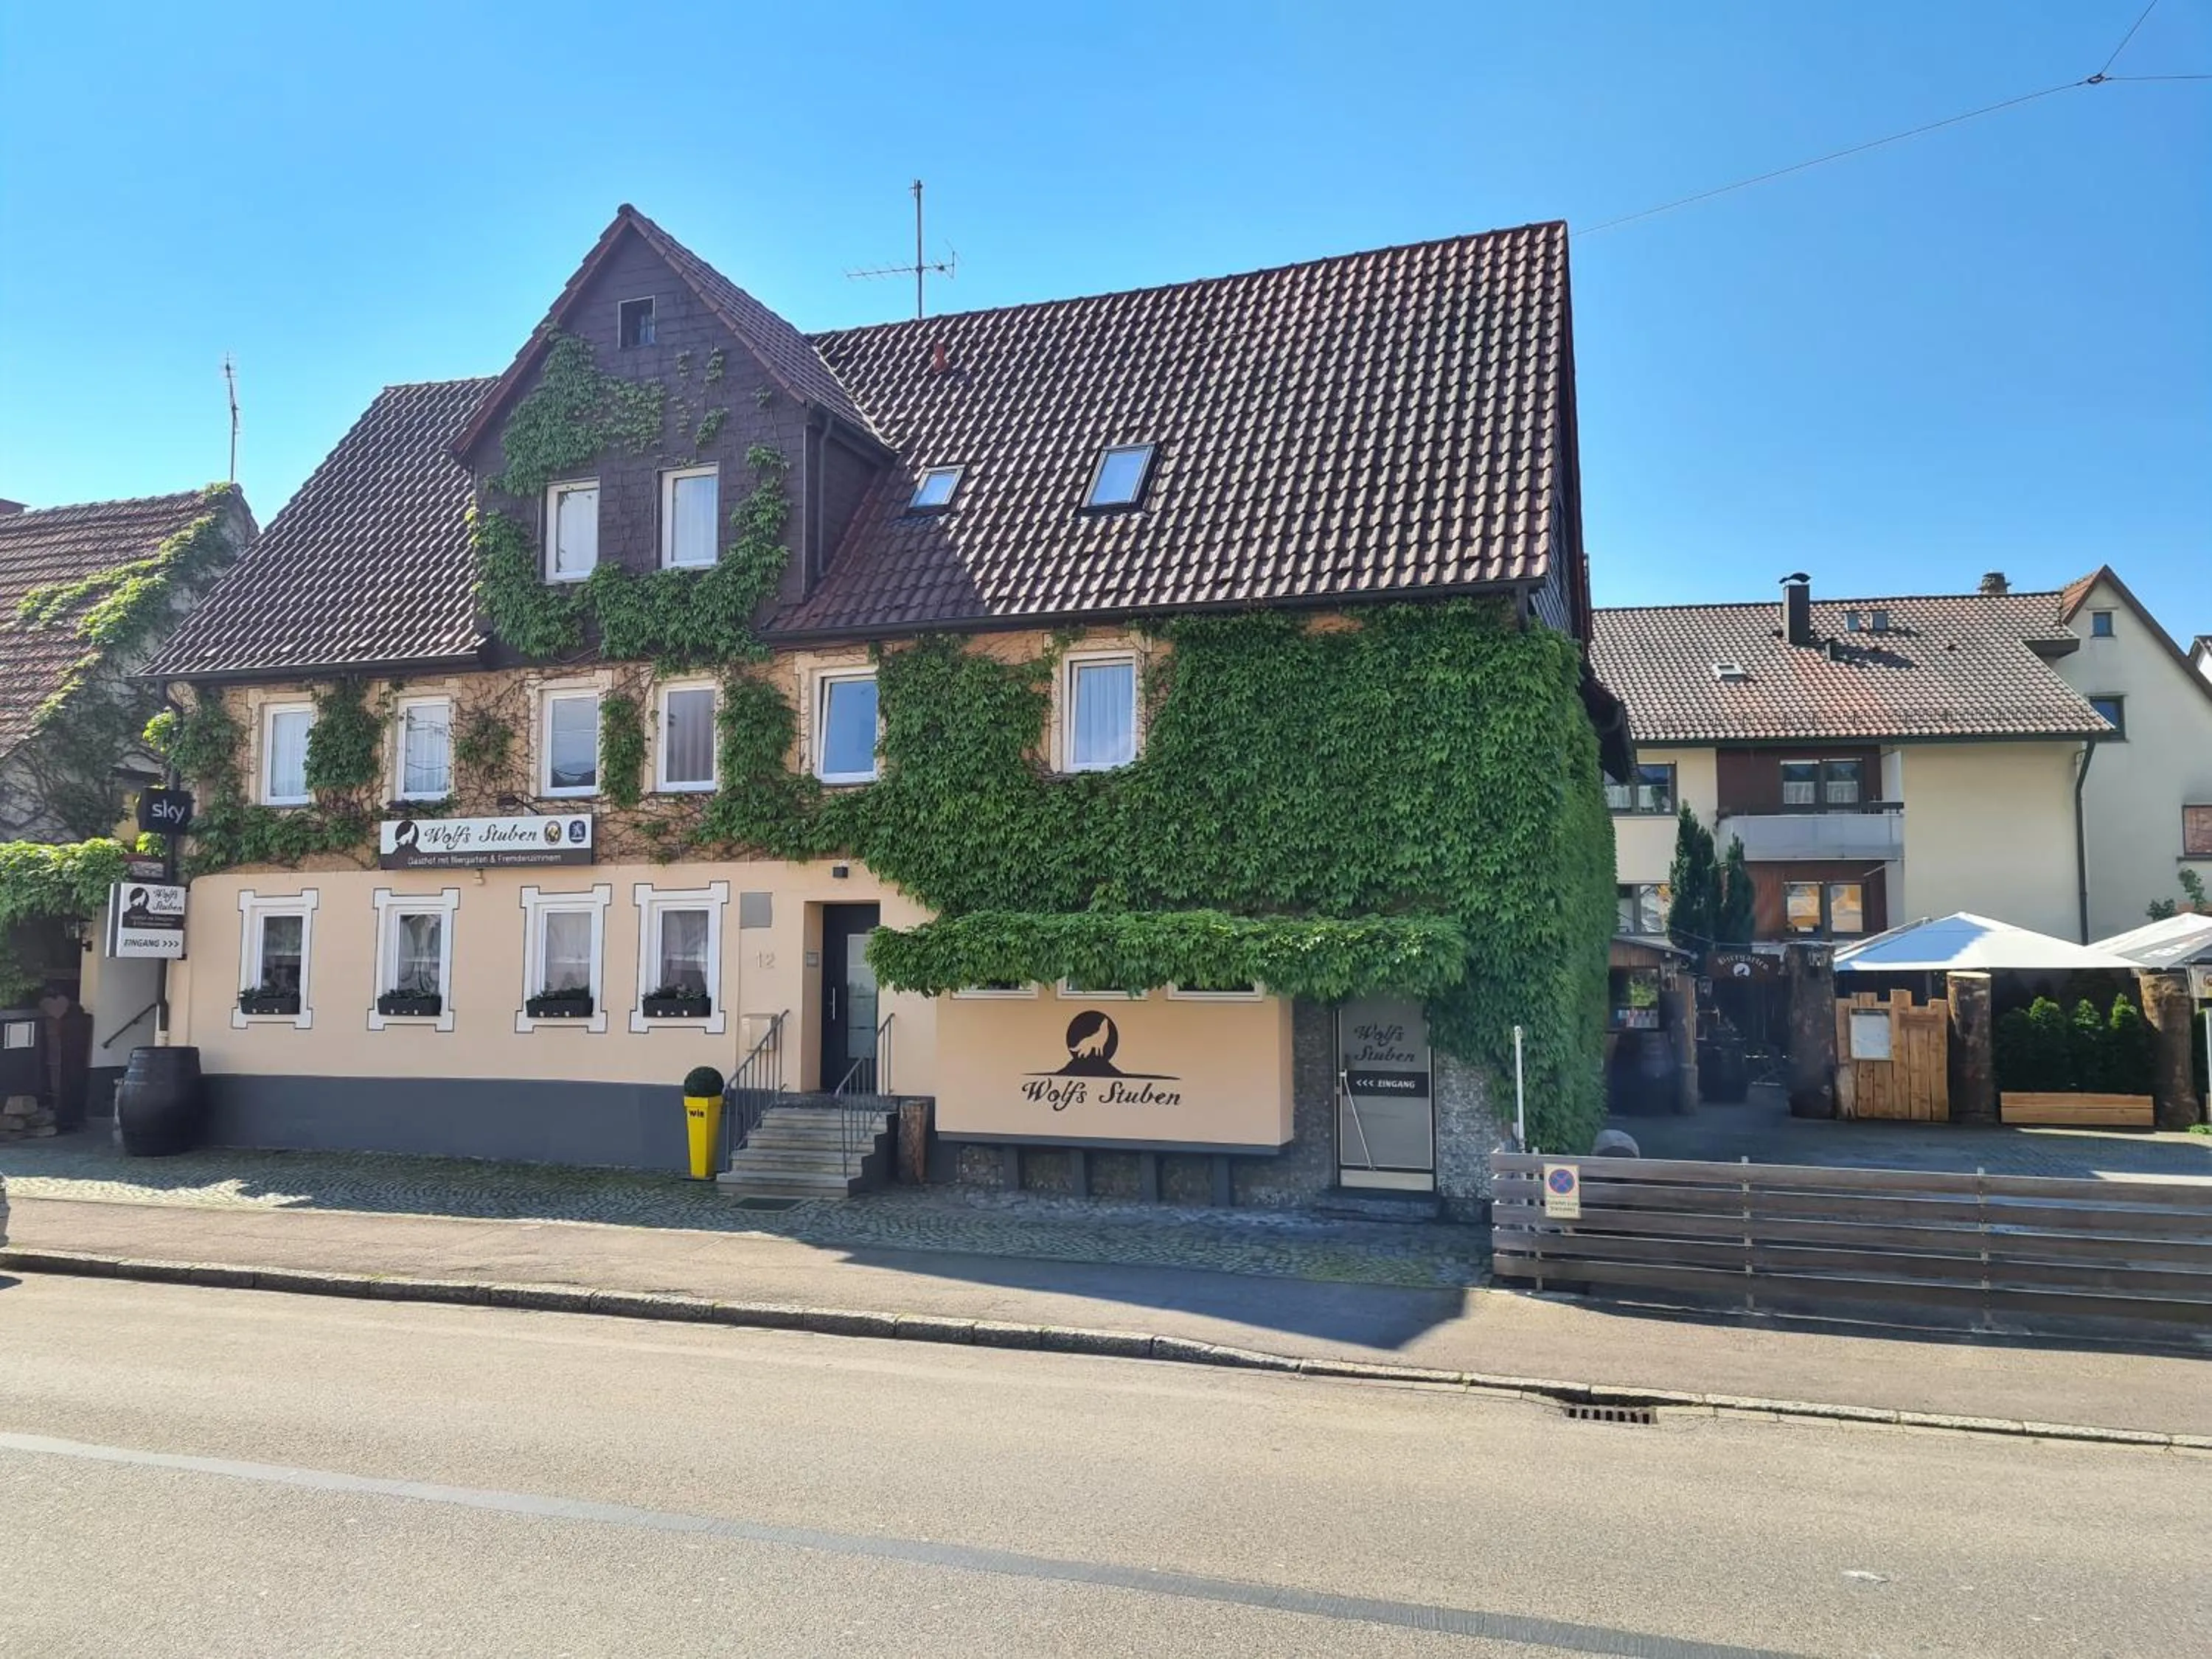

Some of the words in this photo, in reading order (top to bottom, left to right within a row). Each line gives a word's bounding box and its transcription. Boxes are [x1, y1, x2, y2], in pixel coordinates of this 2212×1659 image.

[152, 799, 184, 824] sky
[479, 824, 537, 842] Stuben
[124, 939, 160, 947] EINGANG
[757, 951, 776, 970] 12
[1354, 1046, 1415, 1062] Stuben
[1098, 1081, 1182, 1105] Stuben
[1377, 1079, 1416, 1089] EINGANG
